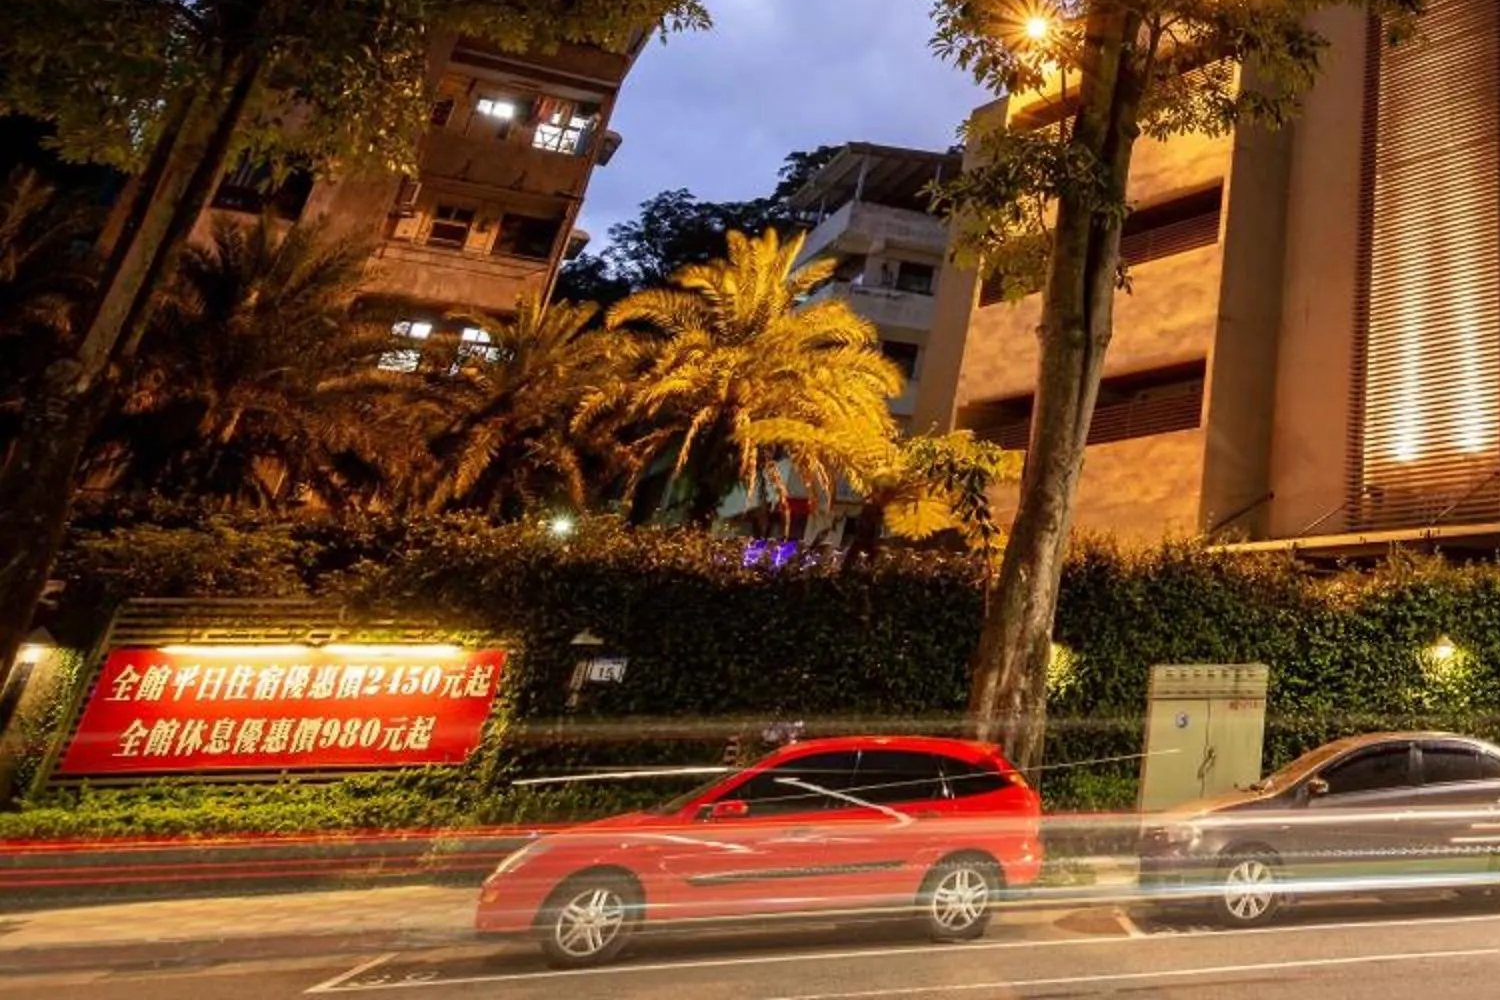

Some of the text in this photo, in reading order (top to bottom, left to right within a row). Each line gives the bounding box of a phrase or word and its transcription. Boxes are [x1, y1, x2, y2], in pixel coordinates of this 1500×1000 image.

[112, 716, 435, 757] 全館休息優惠價980元起
